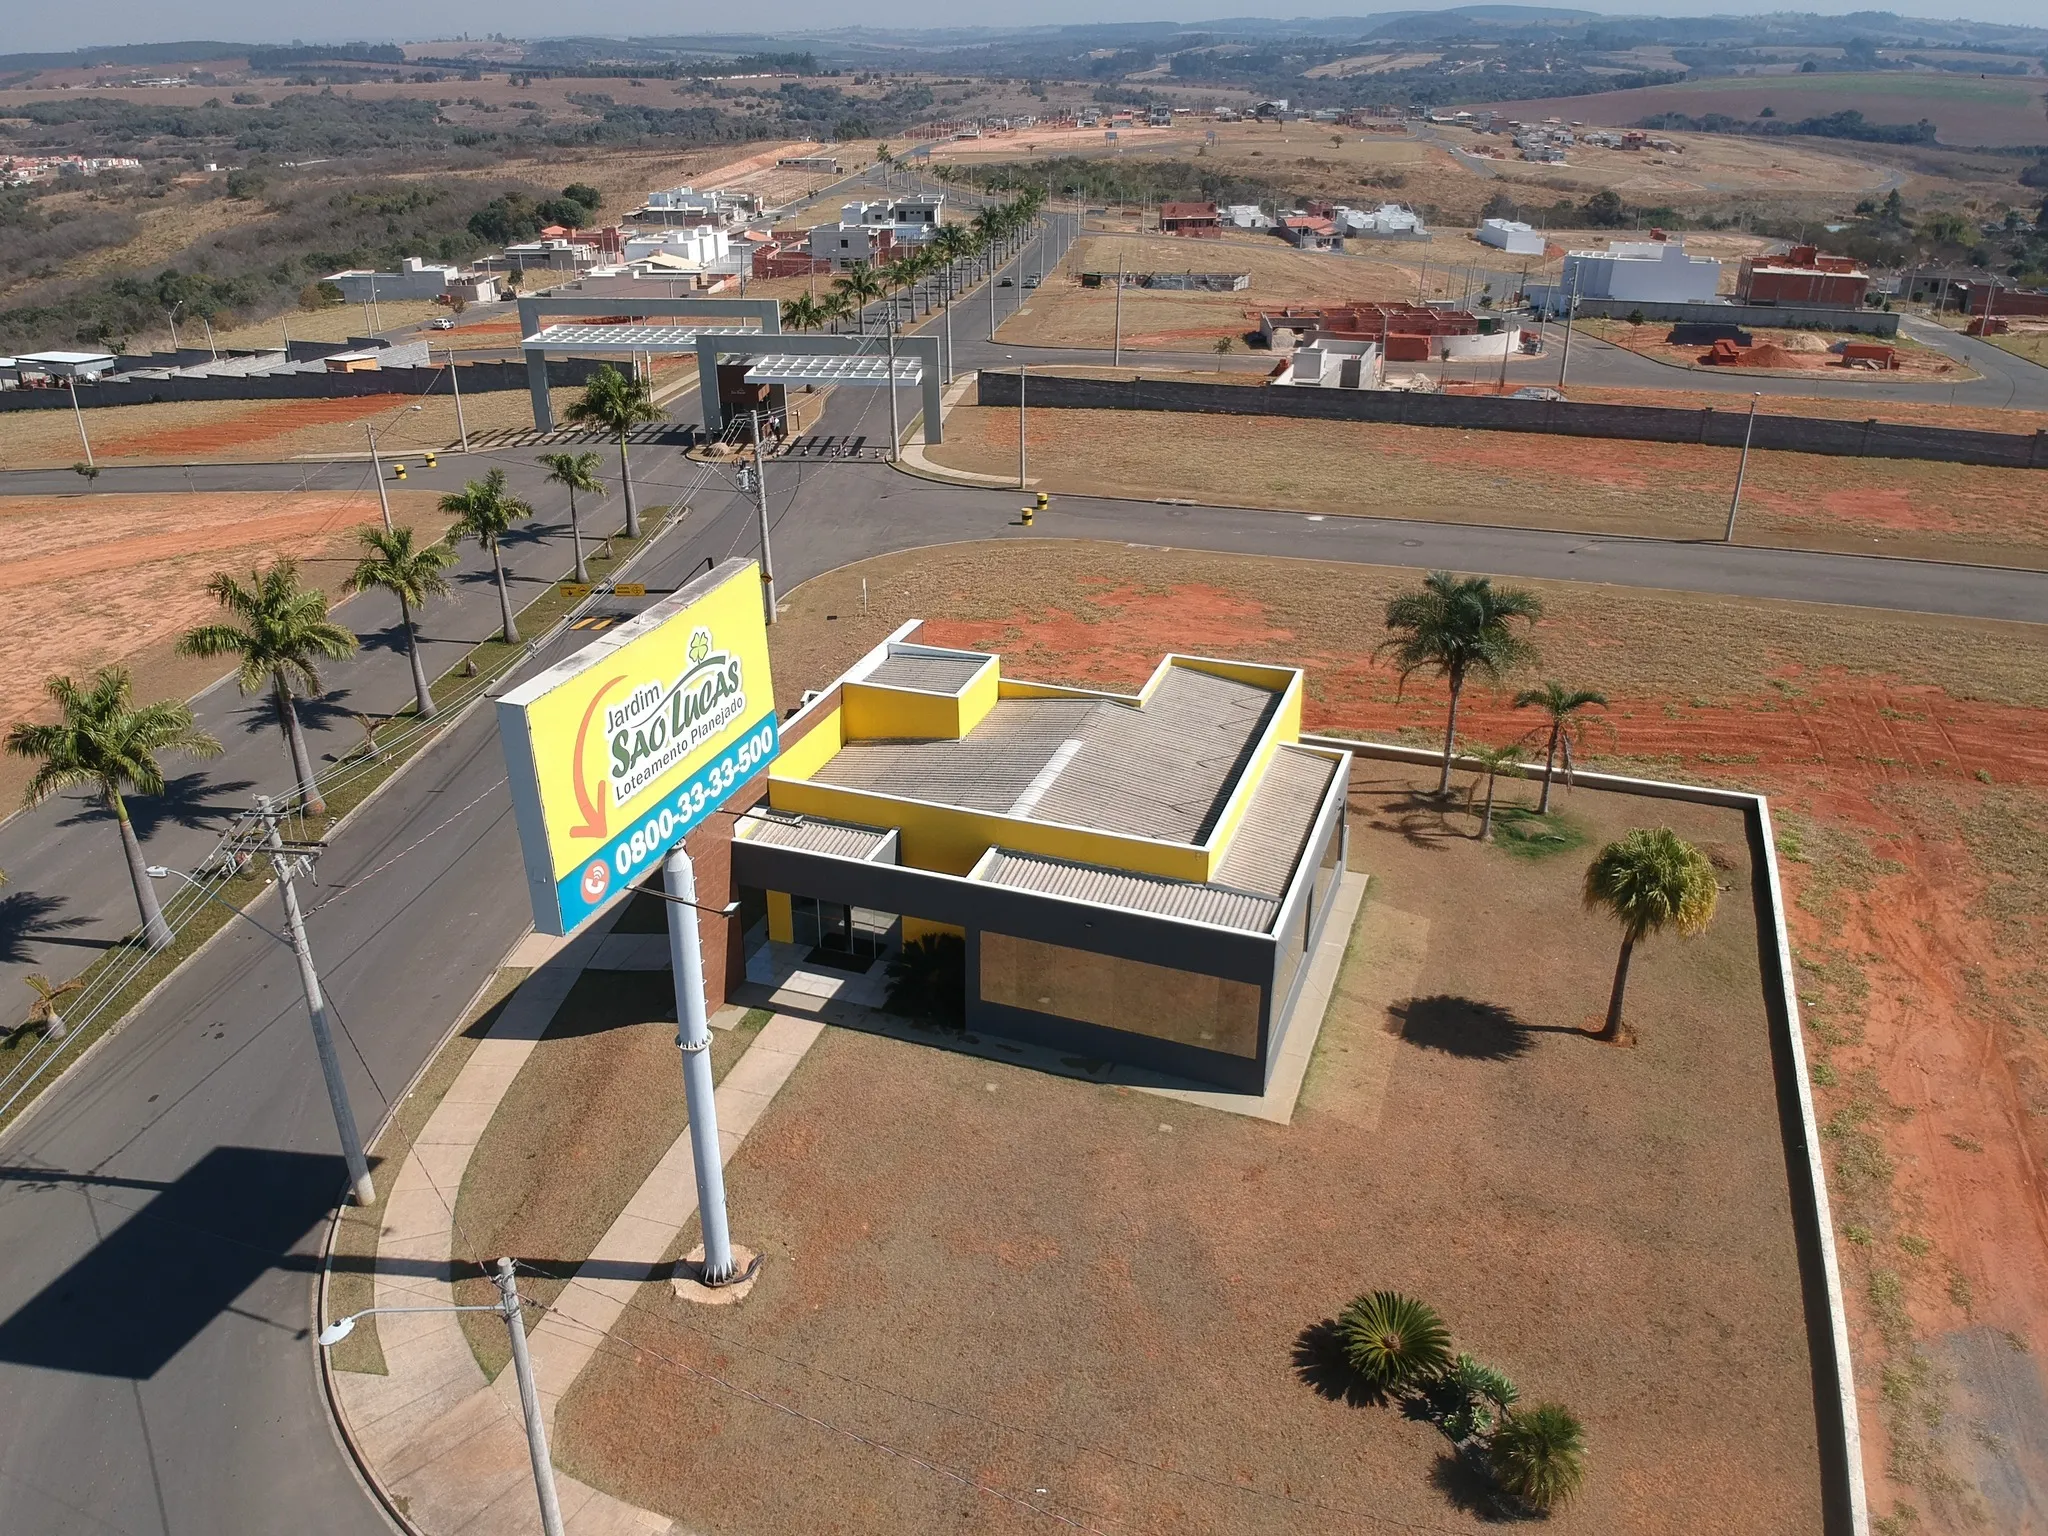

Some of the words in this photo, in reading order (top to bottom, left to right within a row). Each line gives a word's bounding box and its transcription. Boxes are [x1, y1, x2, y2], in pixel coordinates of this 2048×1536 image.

[608, 685, 660, 734] Jardim
[616, 739, 688, 801] Loteamento
[690, 697, 743, 744] Planejado
[615, 725, 773, 875] 0800-33-33-500
